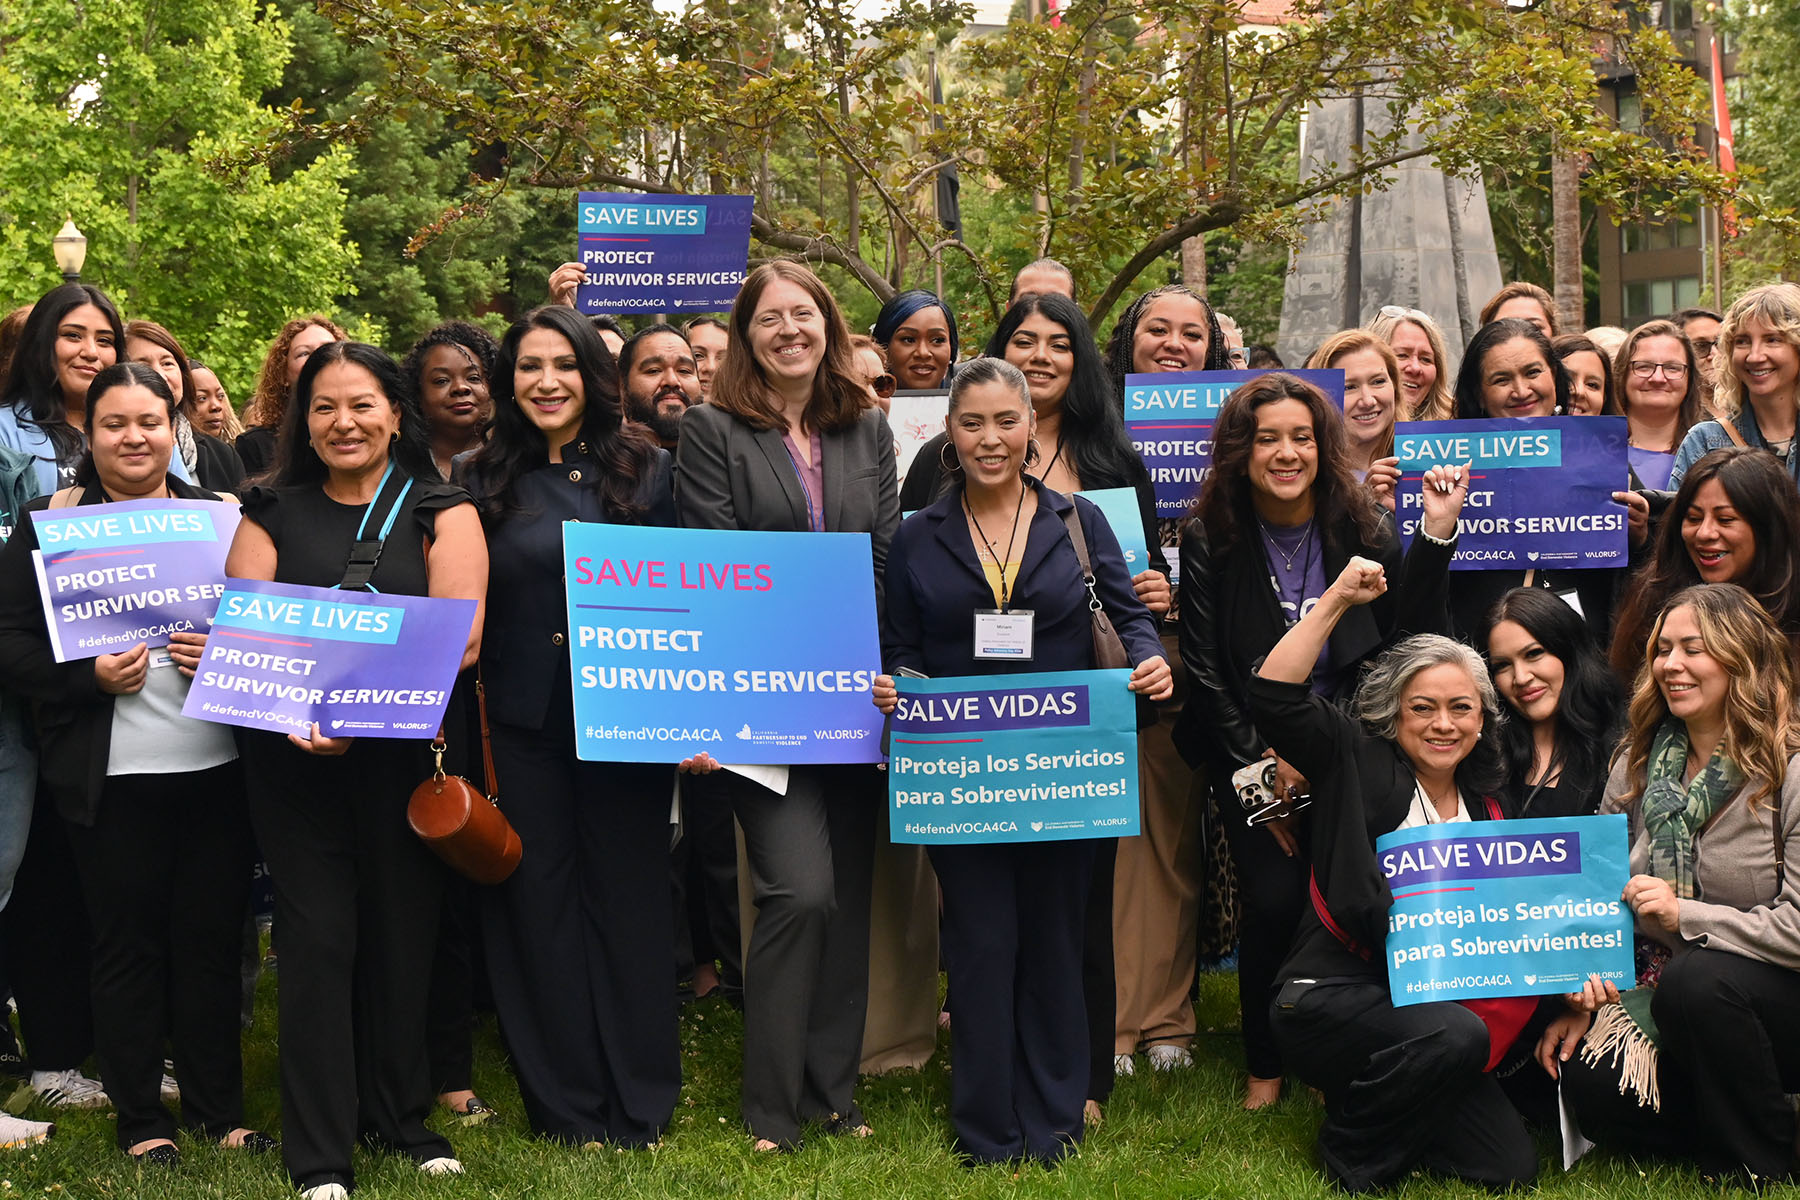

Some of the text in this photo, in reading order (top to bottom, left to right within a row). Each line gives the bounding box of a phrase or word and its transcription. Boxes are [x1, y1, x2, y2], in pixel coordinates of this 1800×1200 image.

[584, 206, 698, 226] SAVE LIVES
[584, 250, 655, 265] PROTECT
[582, 271, 743, 286] SURVIVOR SERVICES!
[587, 298, 666, 308] #defendVOCA4CA
[1131, 389, 1197, 410] SAVE
[1402, 435, 1550, 461] SAVE LIVES
[44, 514, 203, 542] SAVE LIVES
[1402, 515, 1623, 535] SIVOR SERVICES!
[55, 563, 157, 592] PROTECT
[575, 556, 773, 592] SAVE LIVES
[61, 587, 184, 623] SURVIVOR
[225, 596, 391, 633] SAVE LIVES
[78, 619, 195, 648] #defendVOCA4CA
[578, 626, 703, 652] PROTECT
[210, 646, 317, 676] PROTECT
[201, 671, 445, 706] SURVIVOR SERVICES!
[581, 666, 877, 693] SURVIVOR SERVICES!
[896, 691, 1077, 722] SALVE VIDAS
[585, 725, 723, 742] #defendVOCA4CA
[813, 729, 864, 739] VALORUS
[895, 749, 1125, 779] ¡Proteja los Servicios
[895, 778, 1127, 808] para Sobrevivientes!
[905, 821, 1018, 834] #defendVOCA4CA
[1092, 817, 1128, 827] VALORUS
[1383, 838, 1568, 879] SALVE VIDAS
[1389, 899, 1620, 933] ¡Proteja los Servicios
[1393, 930, 1623, 969] para Sobrevivientes!
[1406, 974, 1513, 994] #defendVOCA4CA
